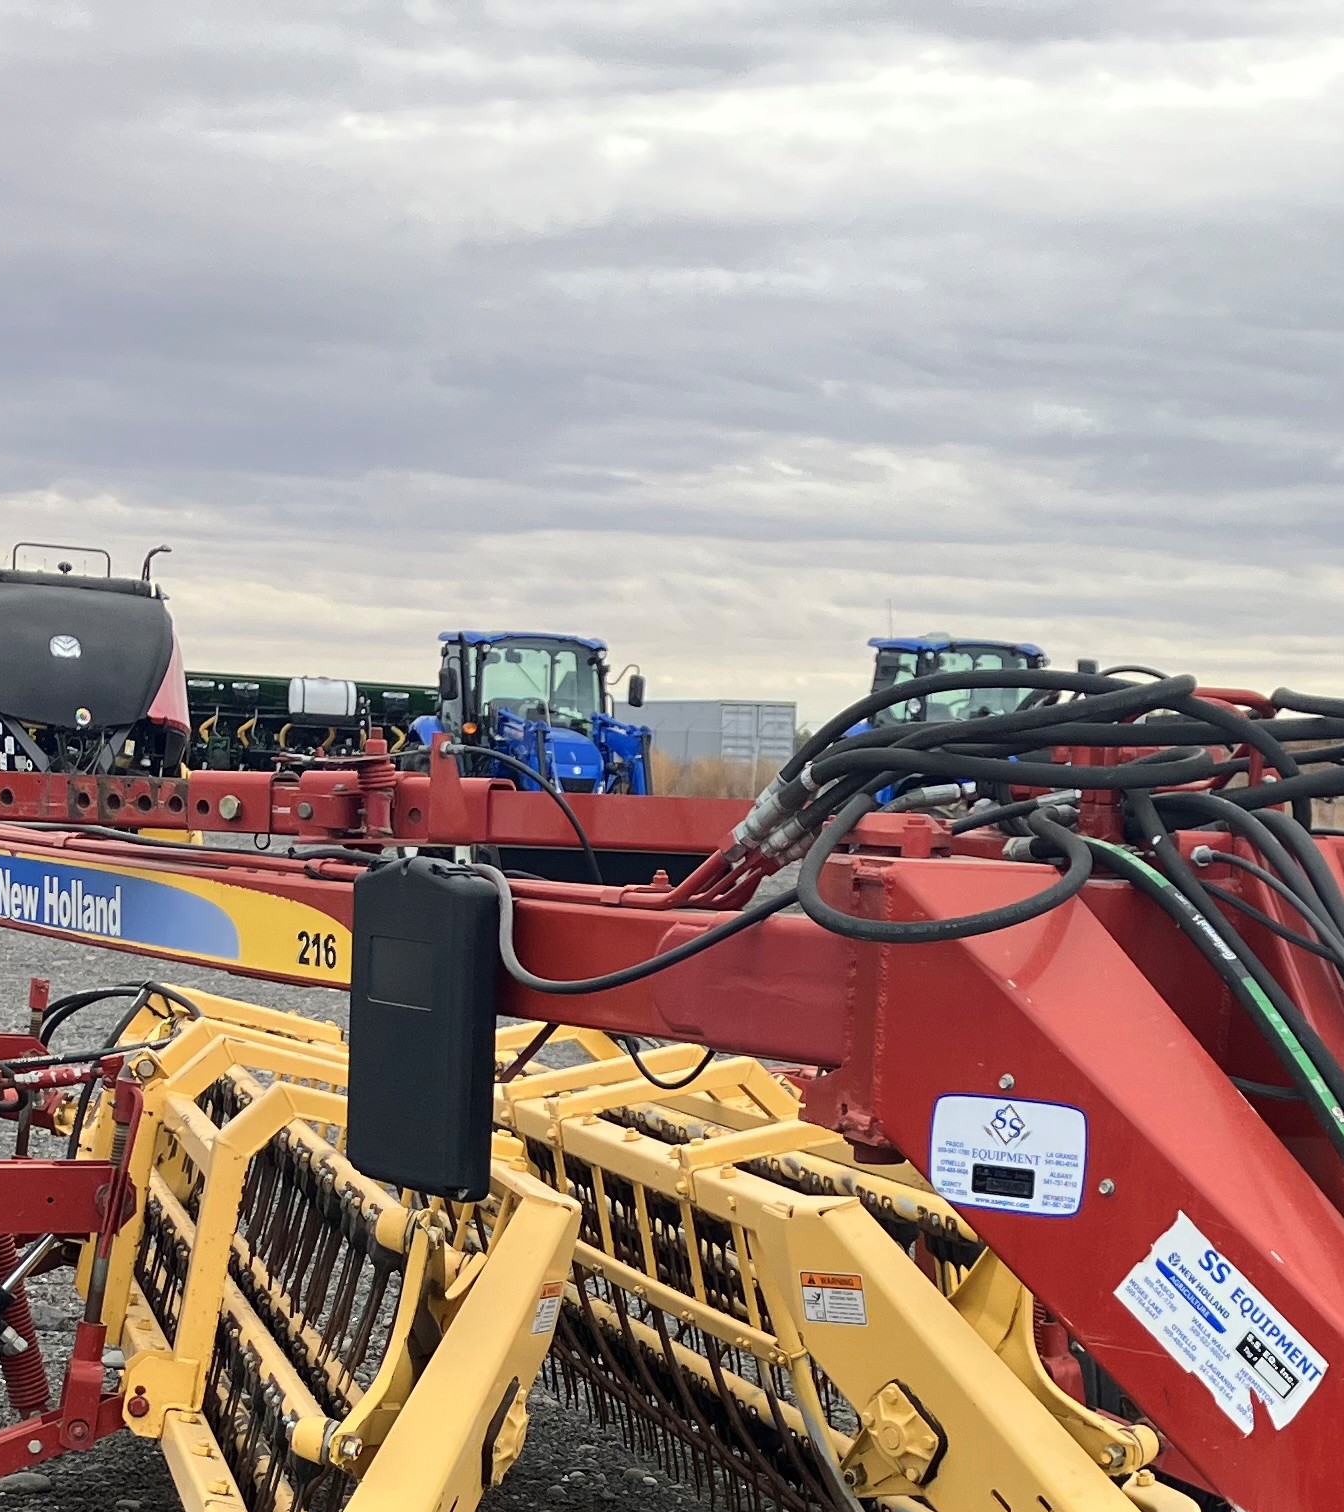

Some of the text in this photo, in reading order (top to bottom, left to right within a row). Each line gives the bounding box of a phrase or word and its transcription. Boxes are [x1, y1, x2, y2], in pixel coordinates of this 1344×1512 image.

[44, 875, 121, 936] Holland
[297, 930, 337, 969] 216
[971, 1147, 1041, 1166] EQUIPMENT
[1129, 1278, 1164, 1316] MOSES LAKE
[1155, 1278, 1175, 1300] PASCO
[1168, 1275, 1212, 1319] AGRICULTURE
[1177, 1264, 1230, 1319] NEW HOLLAND
[1198, 1250, 1323, 1382] SS EQUIPMENT
[1171, 1324, 1197, 1352] OTHELLO
[1191, 1316, 1231, 1360] WALLA WALLA
[1205, 1360, 1236, 1393] LAGRANDE
[1239, 1368, 1275, 1405] HERMISTON
